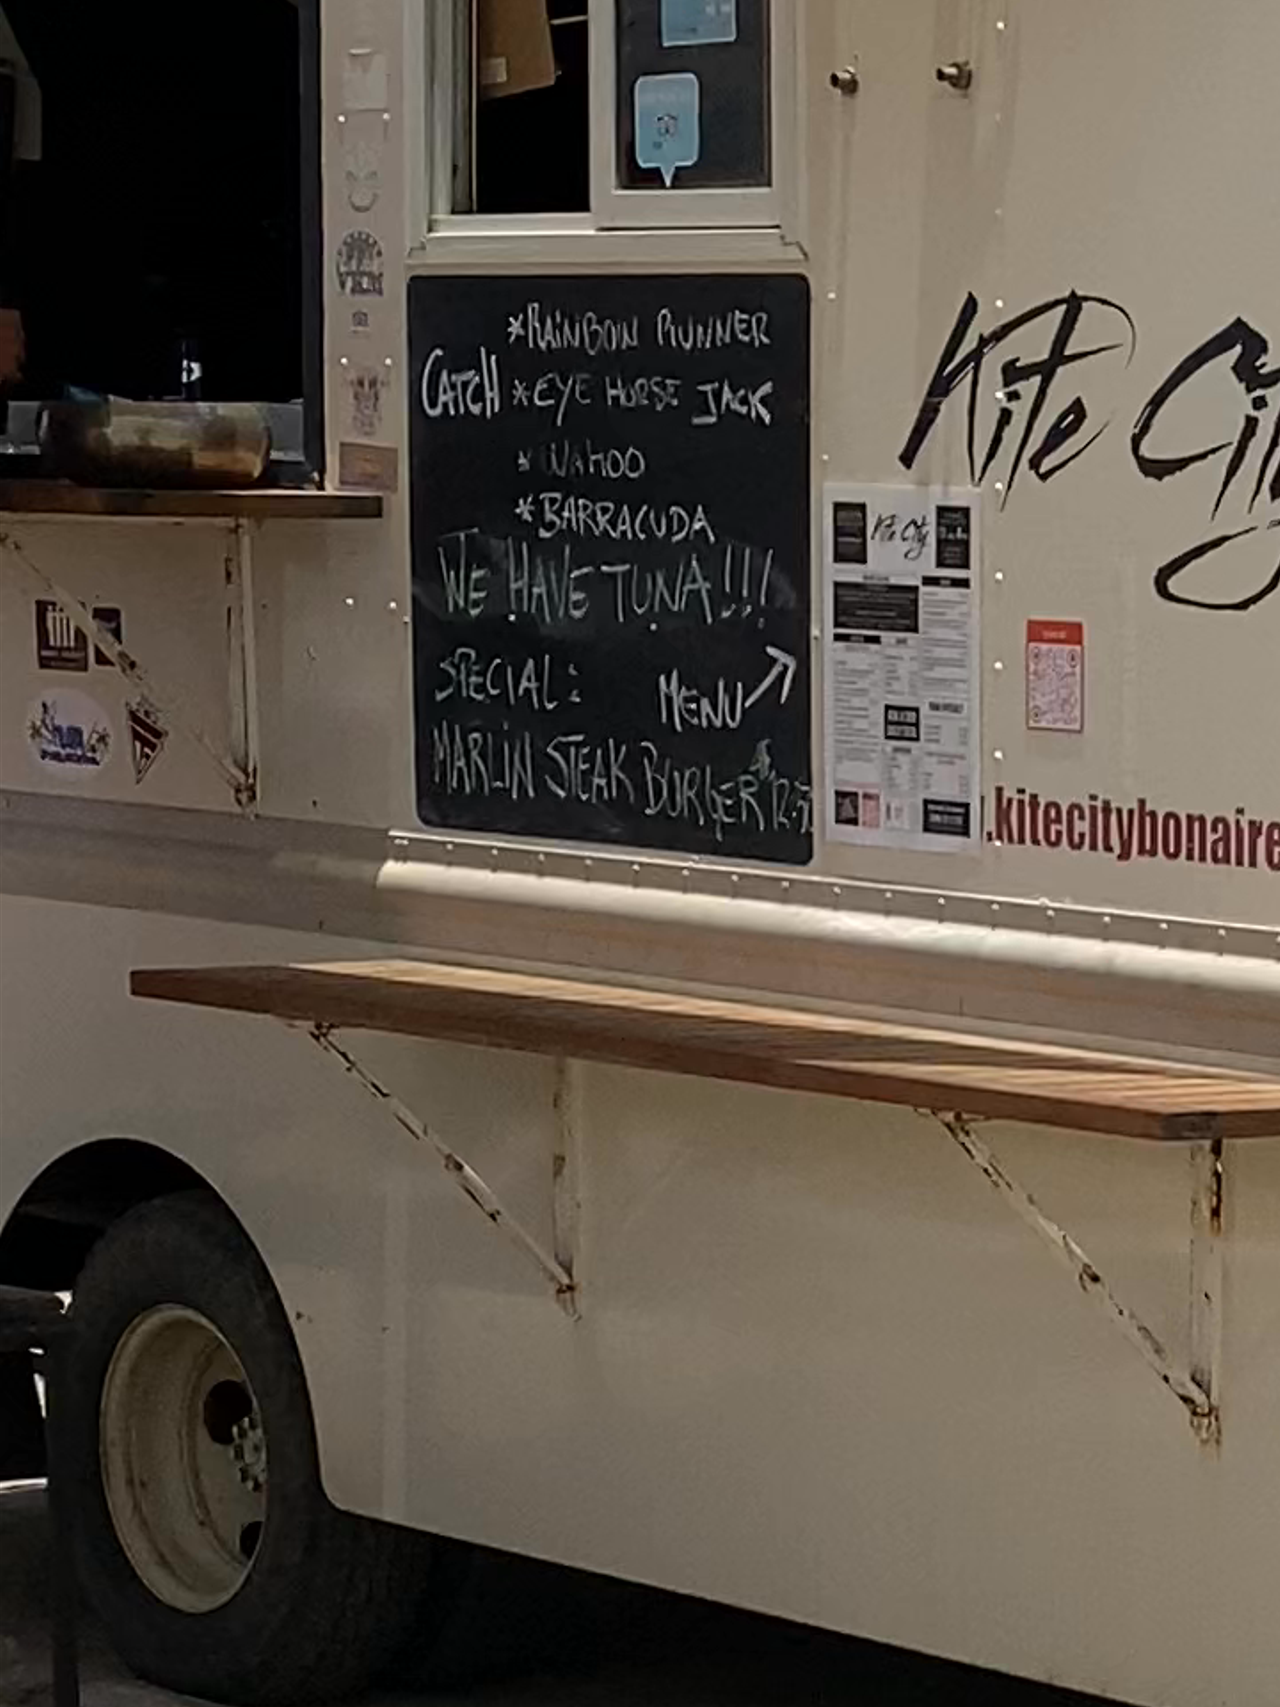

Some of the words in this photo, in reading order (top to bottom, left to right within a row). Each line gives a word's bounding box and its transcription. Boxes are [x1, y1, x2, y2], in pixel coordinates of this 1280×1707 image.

[657, 306, 771, 351] RUNNER
[421, 345, 500, 419] CATCH
[691, 377, 773, 426] JACK
[899, 289, 1136, 513] Kite
[438, 526, 491, 618] WE
[507, 535, 596, 623] HAVE
[658, 667, 744, 733] MENU
[544, 733, 635, 804] STEAK
[641, 741, 766, 842] BURGER
